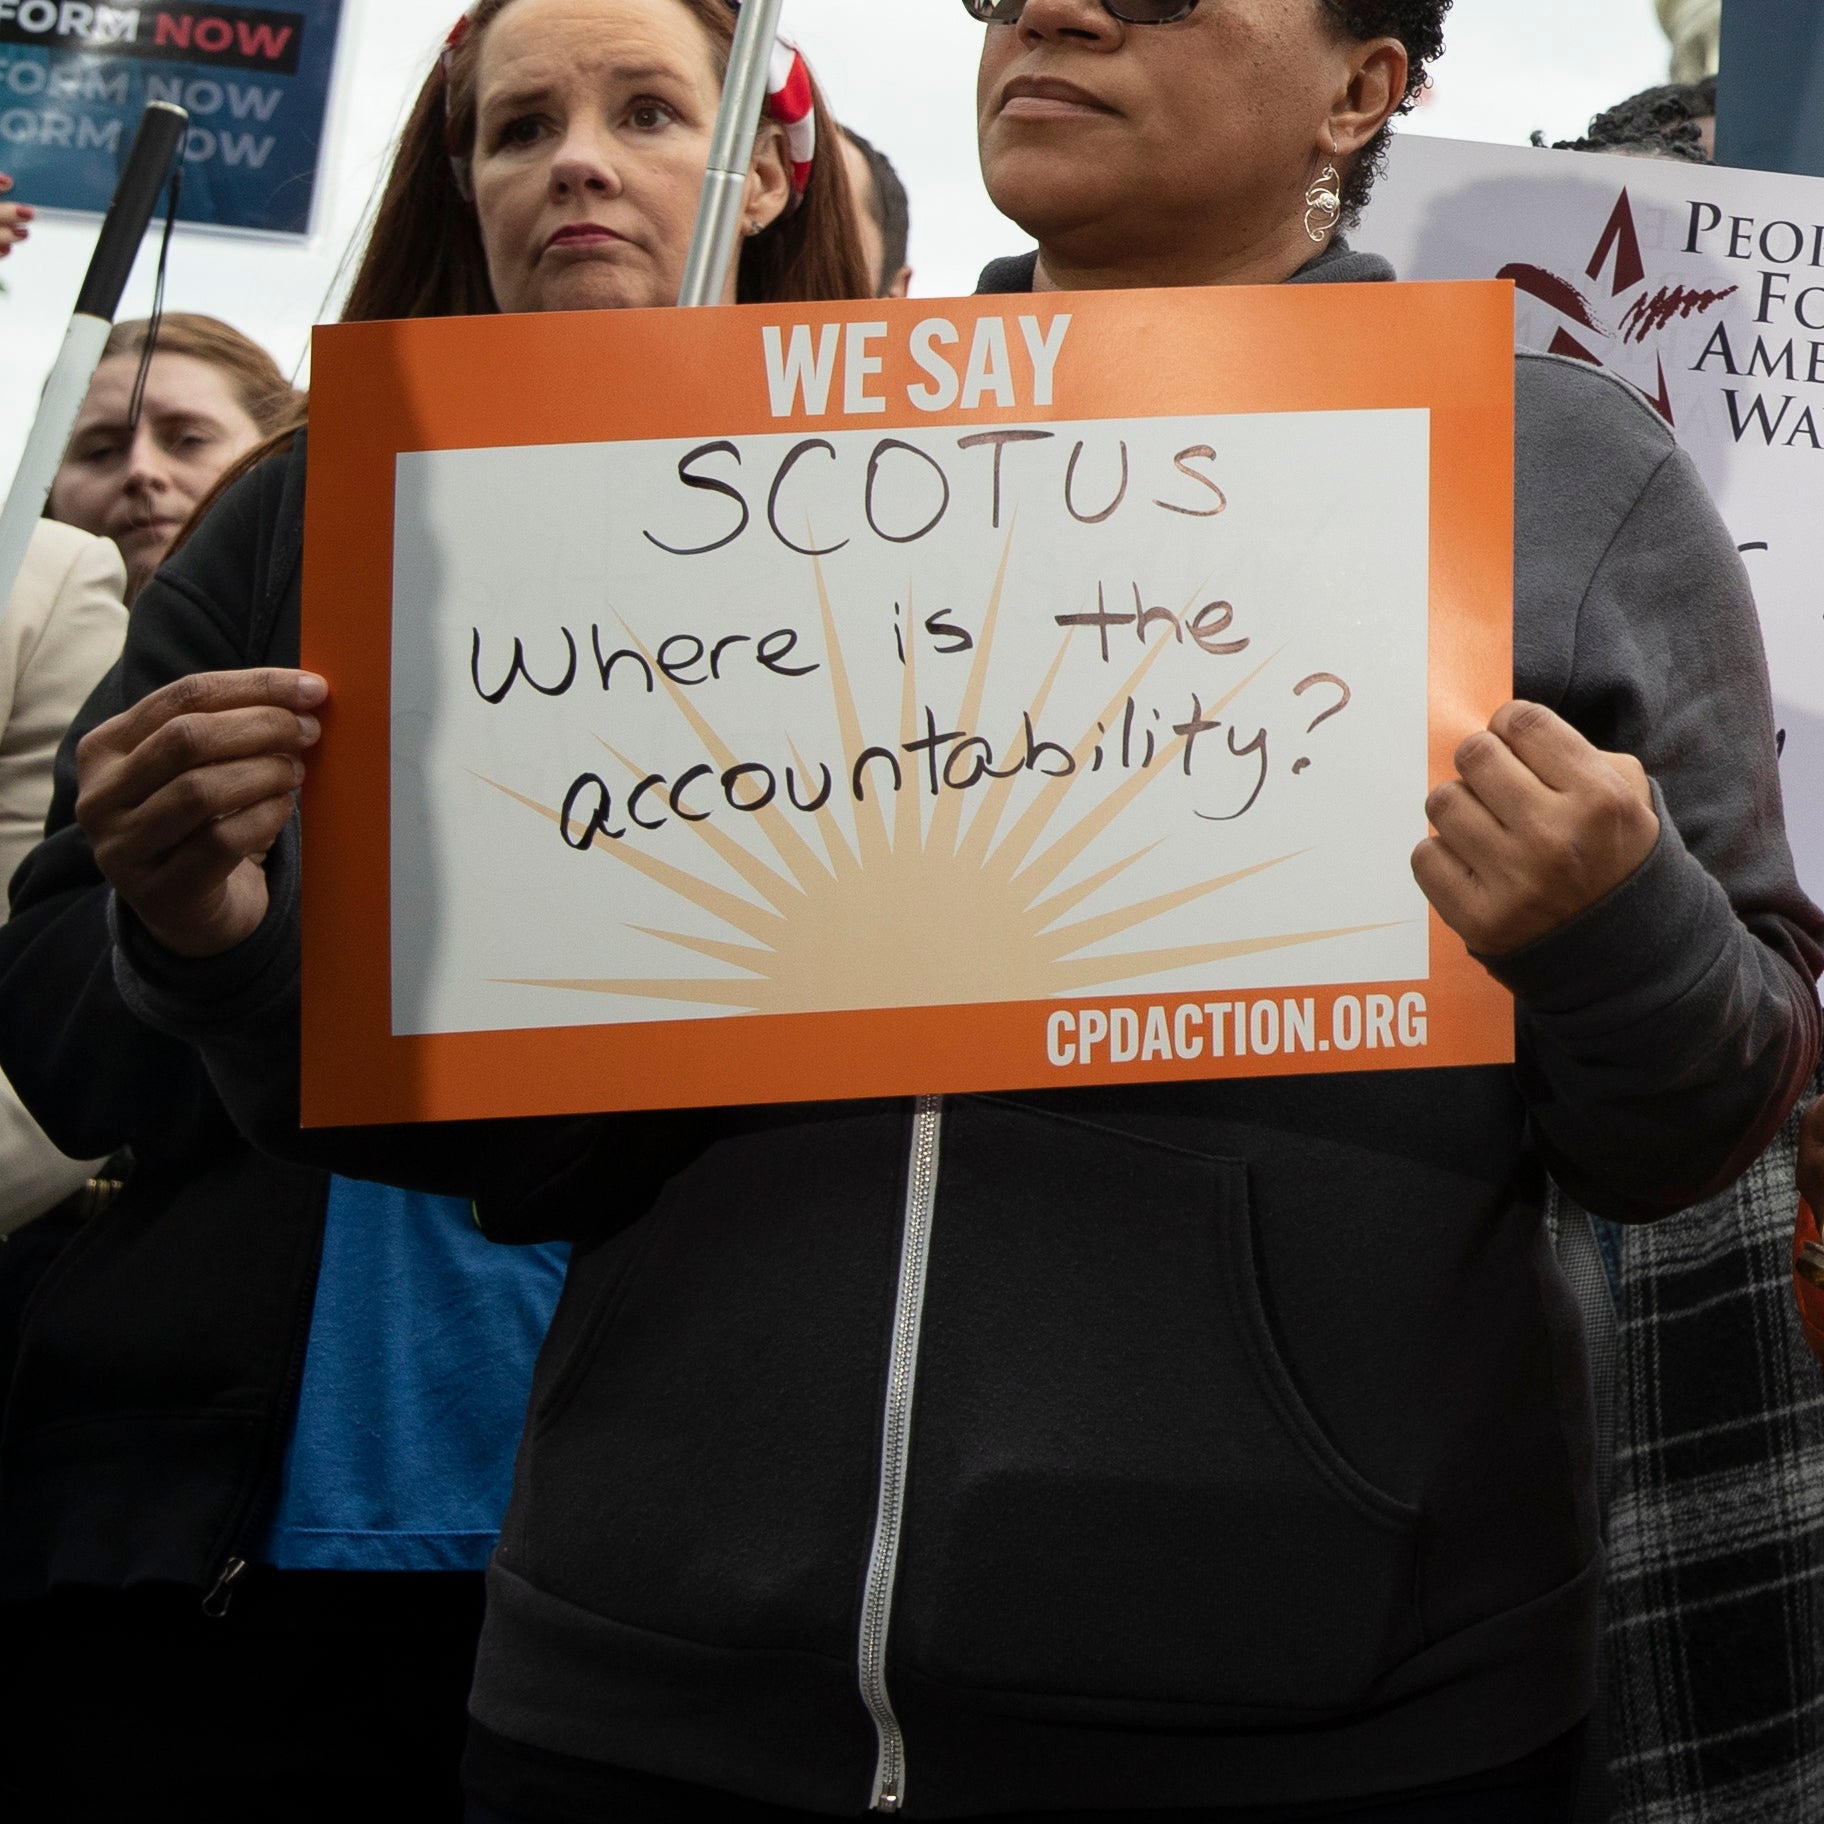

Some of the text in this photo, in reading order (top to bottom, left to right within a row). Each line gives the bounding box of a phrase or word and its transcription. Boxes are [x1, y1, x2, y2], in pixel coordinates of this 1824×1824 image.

[153, 11, 293, 60] NOW
[762, 313, 1072, 417] WE SAY
[642, 430, 1226, 556] SCOTUS
[896, 602, 975, 667] is
[1055, 580, 1249, 662] the
[559, 671, 1351, 851] accountability?
[1046, 992, 1428, 1068] CPDACTION.ORG
